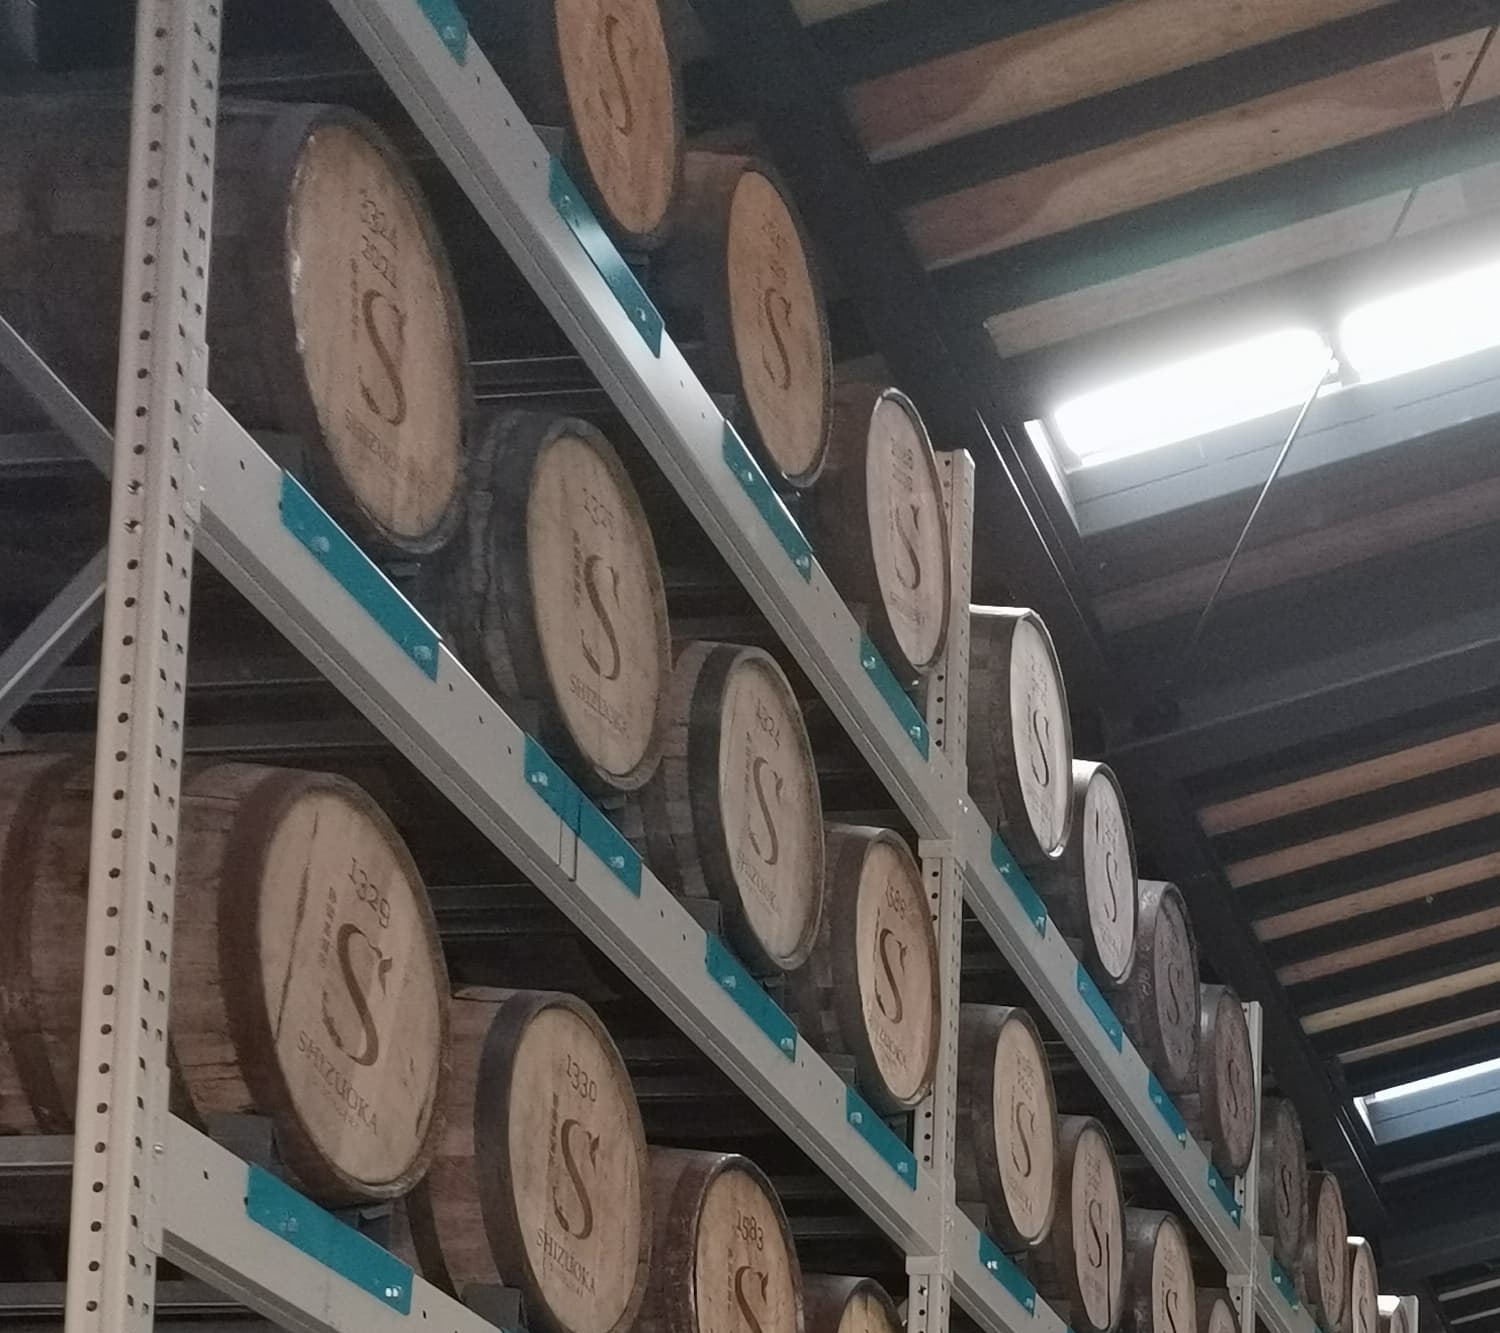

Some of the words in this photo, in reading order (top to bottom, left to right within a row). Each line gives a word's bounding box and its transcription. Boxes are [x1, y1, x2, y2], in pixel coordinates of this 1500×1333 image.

[603, 14, 639, 137] S
[358, 288, 407, 426] S
[760, 286, 792, 392] S
[894, 503, 922, 592] S
[581, 553, 622, 682] S
[1026, 706, 1056, 788] S
[747, 756, 784, 867] S
[321, 922, 393, 1068] S
[874, 926, 908, 1026] S
[1166, 961, 1185, 1027] S
[566, 1053, 599, 1104] 1330
[552, 1118, 602, 1242] S
[1011, 1101, 1038, 1178] S
[536, 1226, 598, 1298] SHIZUOKA
[736, 1208, 765, 1252] 1583
